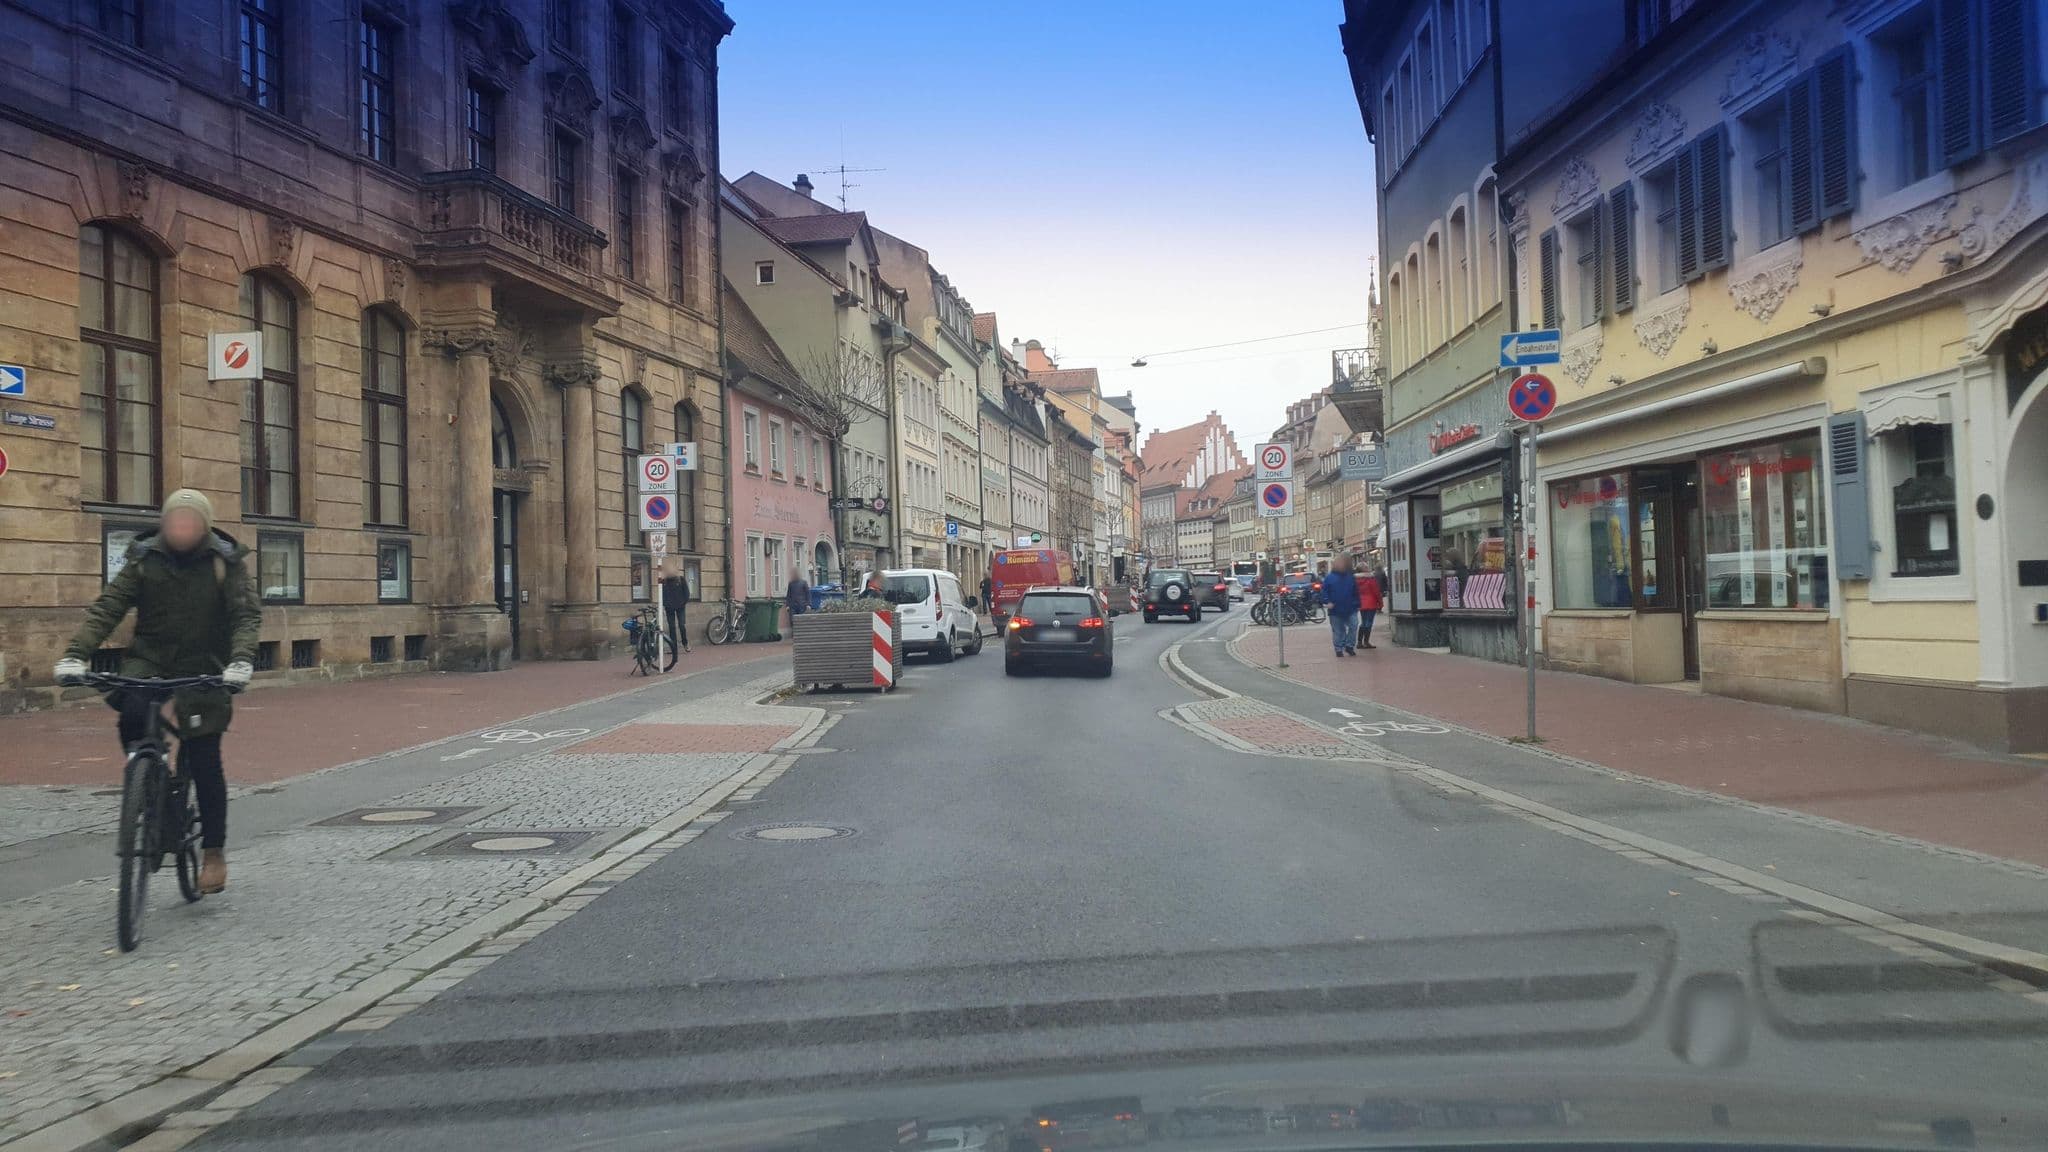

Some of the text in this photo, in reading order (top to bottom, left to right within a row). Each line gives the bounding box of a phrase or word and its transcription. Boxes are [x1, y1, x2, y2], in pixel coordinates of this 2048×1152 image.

[1516, 342, 1556, 354] Einbahnstraße
[1267, 452, 1281, 464] 20
[1348, 454, 1377, 466] BVD
[650, 464, 665, 476] 20
[1266, 508, 1285, 516] ZONE
[949, 523, 956, 534] P
